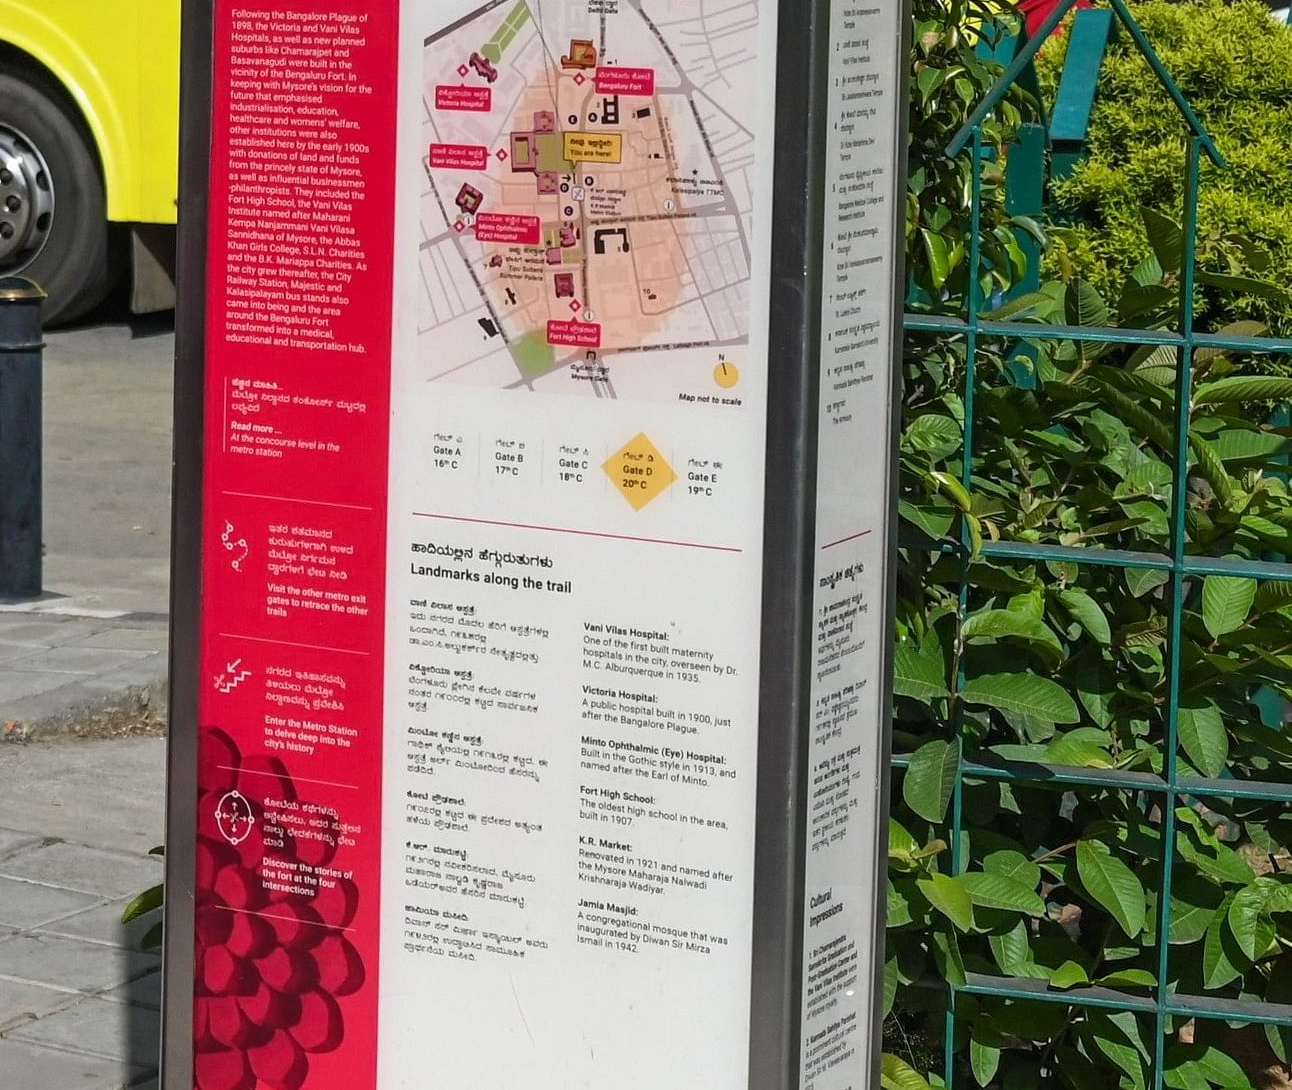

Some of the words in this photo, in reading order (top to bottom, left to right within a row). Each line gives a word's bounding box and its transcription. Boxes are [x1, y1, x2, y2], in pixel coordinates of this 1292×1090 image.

[678, 393, 695, 402] Map
[697, 395, 710, 403] not
[711, 396, 719, 404] to
[721, 397, 742, 406] scale
[433, 445, 453, 455] Gate
[454, 447, 461, 456] A
[495, 451, 515, 462] Gate
[517, 453, 523, 462] B
[451, 460, 457, 469] C
[558, 458, 579, 468] Gate
[581, 460, 588, 469] C
[622, 464, 643, 475] Gate
[646, 466, 652, 476] D
[512, 467, 518, 476] C
[576, 473, 582, 482] C
[687, 471, 709, 482] Gate
[711, 473, 717, 482] E
[640, 480, 647, 489] C
[705, 487, 712, 496] C
[410, 562, 480, 582] Landmarks
[483, 571, 518, 589] along
[522, 576, 542, 589] the
[546, 579, 571, 593] trail
[267, 583, 285, 593] Visit
[287, 586, 300, 595] the
[301, 588, 323, 597] other
[324, 592, 349, 601] metro
[350, 595, 365, 603] exit
[267, 596, 289, 605] gates
[291, 598, 299, 606] to
[301, 600, 330, 610] retrace
[331, 603, 345, 612] the
[346, 606, 368, 615] other
[267, 607, 287, 617] trails
[583, 622, 603, 632] Vani
[605, 624, 627, 635] Vilas
[629, 628, 669, 640] Hospital:
[582, 685, 616, 697] Victoria
[618, 690, 658, 702] Hospital:
[265, 715, 286, 725] Enter
[287, 719, 301, 728] the
[302, 721, 326, 732] Metro
[328, 724, 357, 735] Station
[581, 735, 606, 746] Minto
[608, 739, 658, 754] Ophthalmic
[661, 747, 683, 759] (Eye)
[686, 751, 726, 764] Hospital:
[580, 785, 597, 795] Fort
[600, 788, 620, 800] High
[623, 791, 656, 804] School:
[579, 811, 597, 820] built
[600, 814, 608, 822] in
[611, 815, 635, 825] 1907.
[580, 798, 596, 808] The
[598, 802, 624, 813] oldest
[627, 805, 645, 817] high
[648, 810, 677, 820] school
[690, 816, 704, 825] the
[706, 819, 727, 830] area,
[579, 836, 596, 845] K.R.
[599, 838, 633, 851] Market:
[577, 898, 604, 910] Jamia
[606, 902, 638, 916] Masjid:
